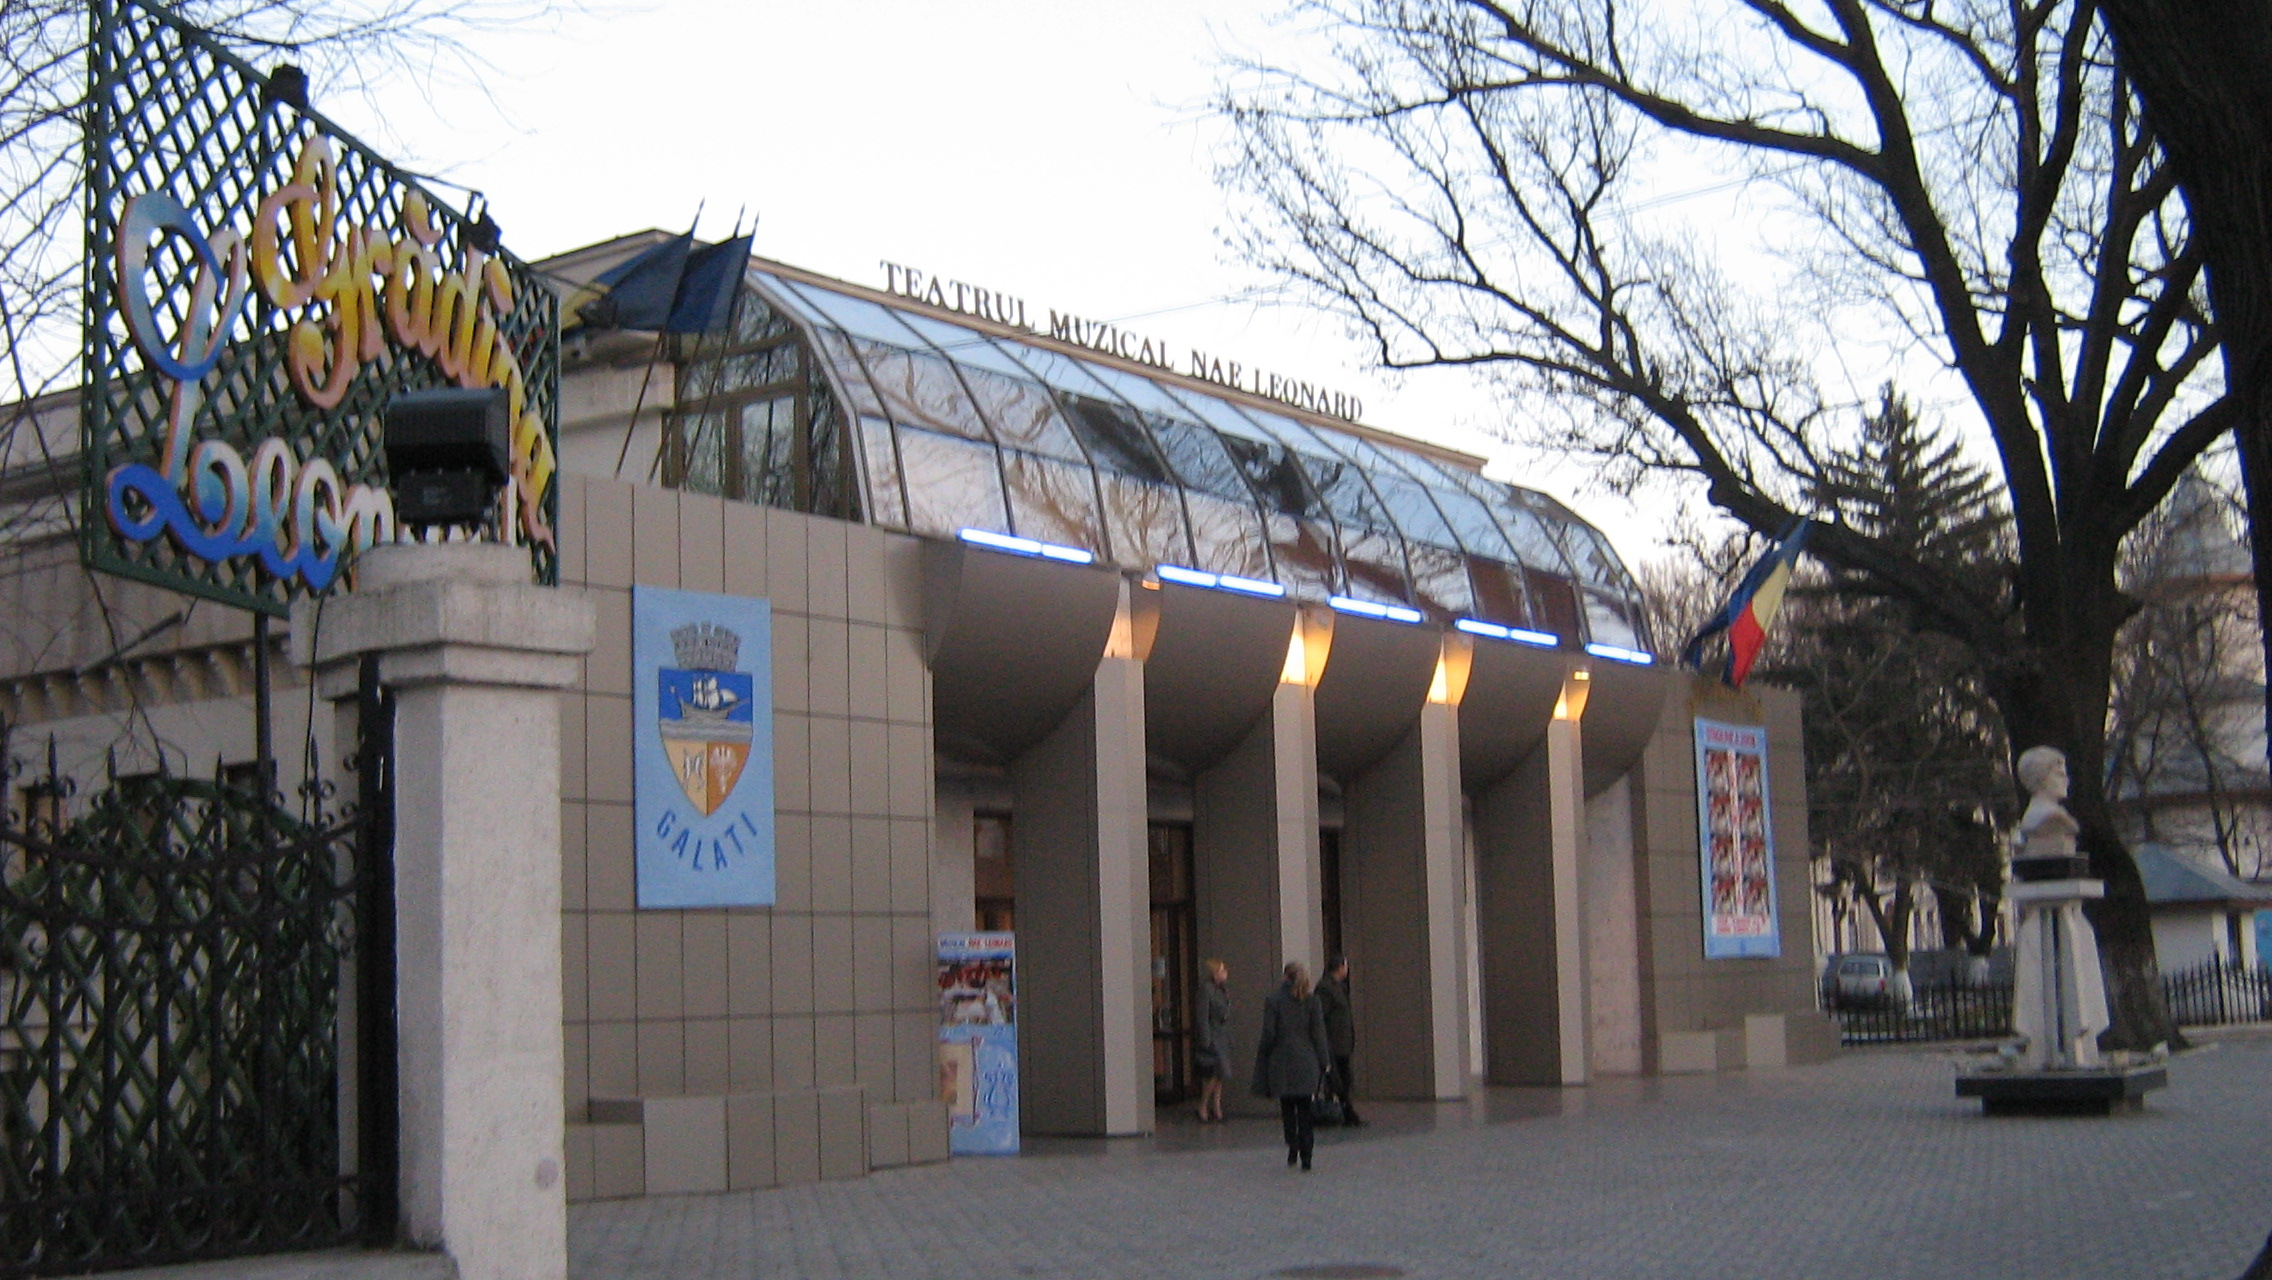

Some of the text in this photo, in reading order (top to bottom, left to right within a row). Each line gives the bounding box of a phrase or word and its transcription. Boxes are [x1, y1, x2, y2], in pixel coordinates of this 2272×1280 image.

[879, 258, 1363, 422] TEATRUL MUZICAL NAE LEONARD
[656, 808, 758, 872] GALATI
